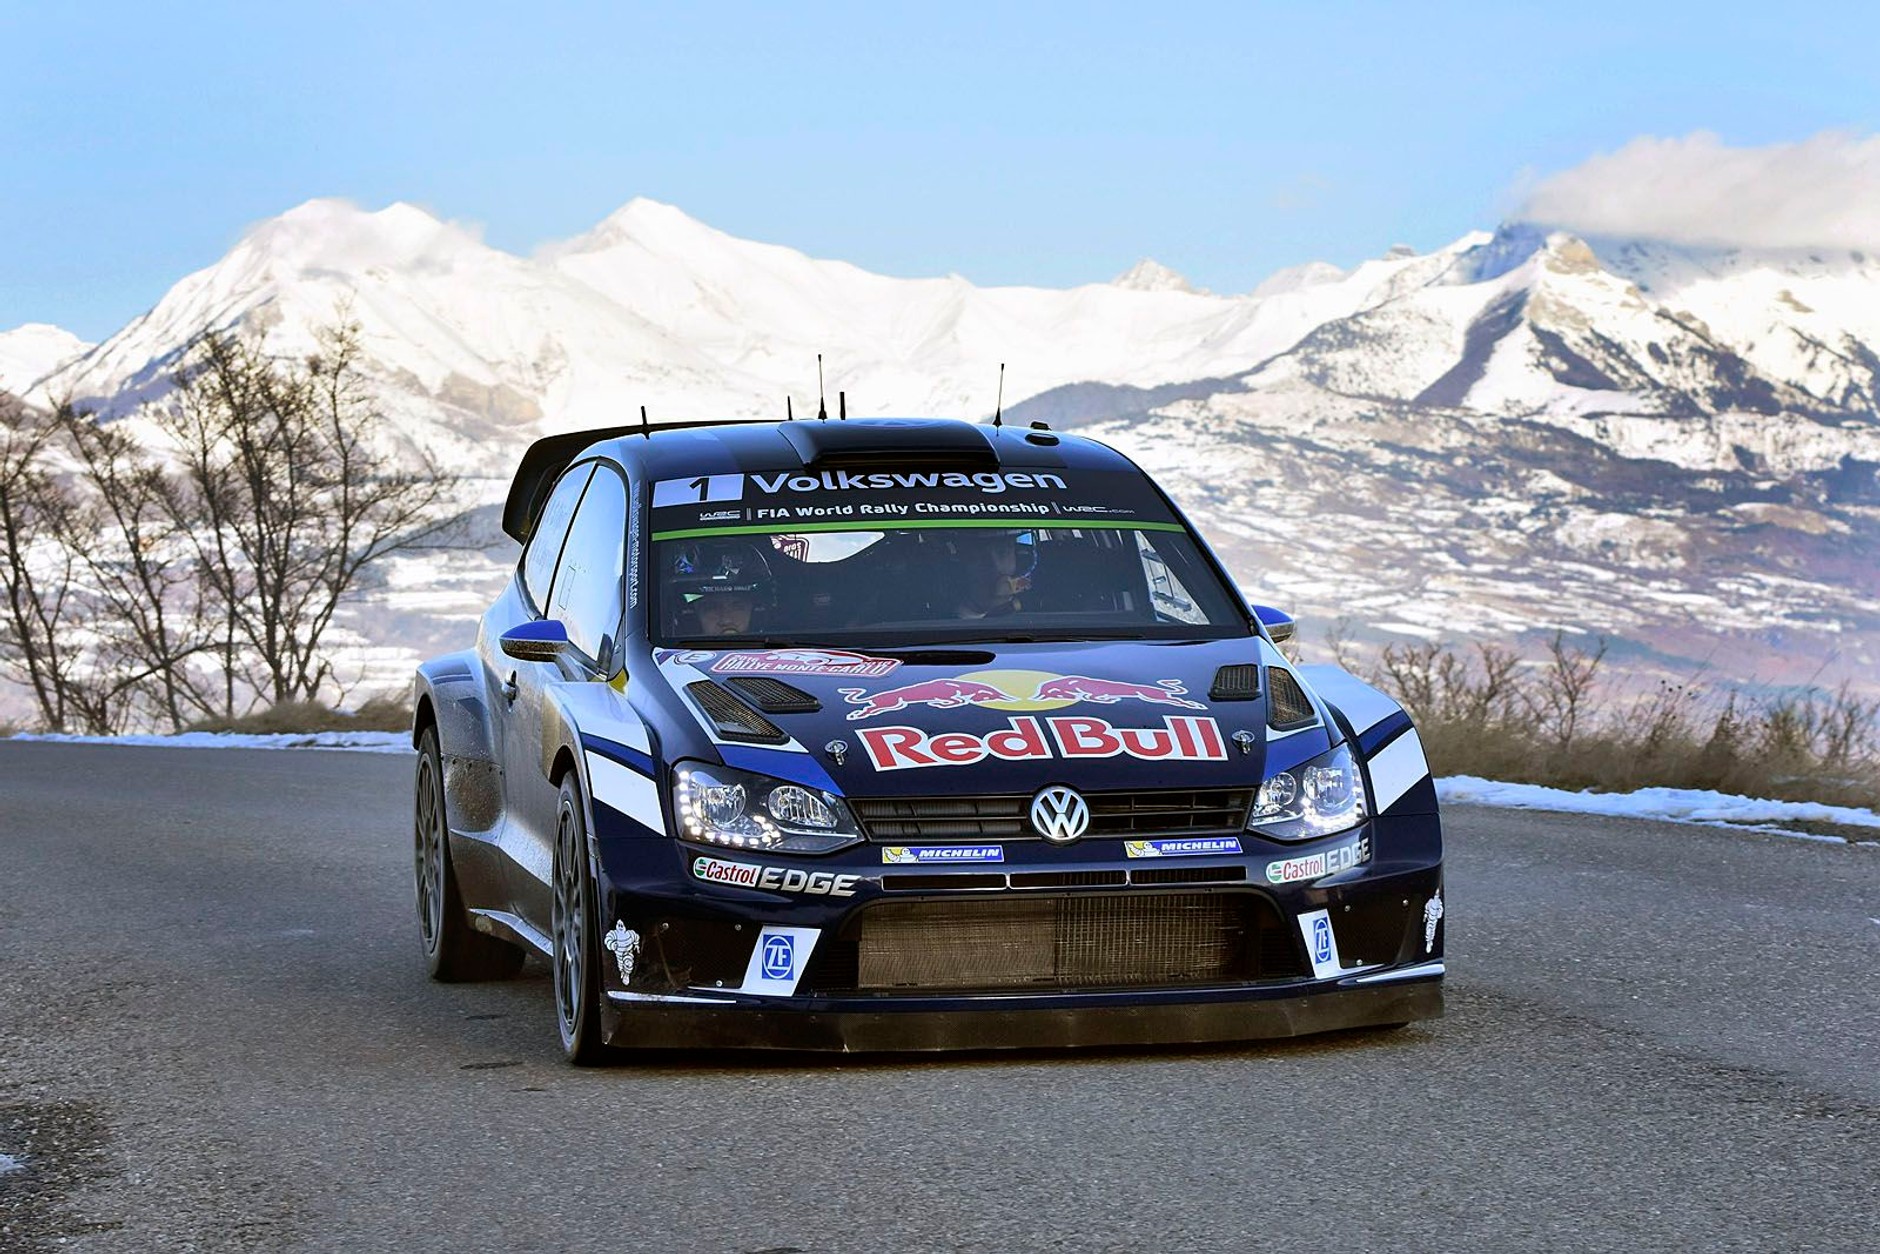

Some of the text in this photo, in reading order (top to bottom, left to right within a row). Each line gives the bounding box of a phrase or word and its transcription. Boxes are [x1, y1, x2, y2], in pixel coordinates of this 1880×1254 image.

[689, 471, 1067, 501] 1 Volkswagen
[758, 508, 790, 519] FIA
[796, 505, 853, 517] World
[861, 504, 908, 517] Rally
[915, 502, 1049, 516] Championship
[855, 715, 1229, 771] Red Bull
[920, 848, 999, 857] MICHELIN
[1161, 840, 1237, 851] MICHELIN
[1283, 837, 1370, 881] Castrol EDGE
[706, 860, 861, 897] Castrol EDGE
[767, 945, 790, 971] ZF
